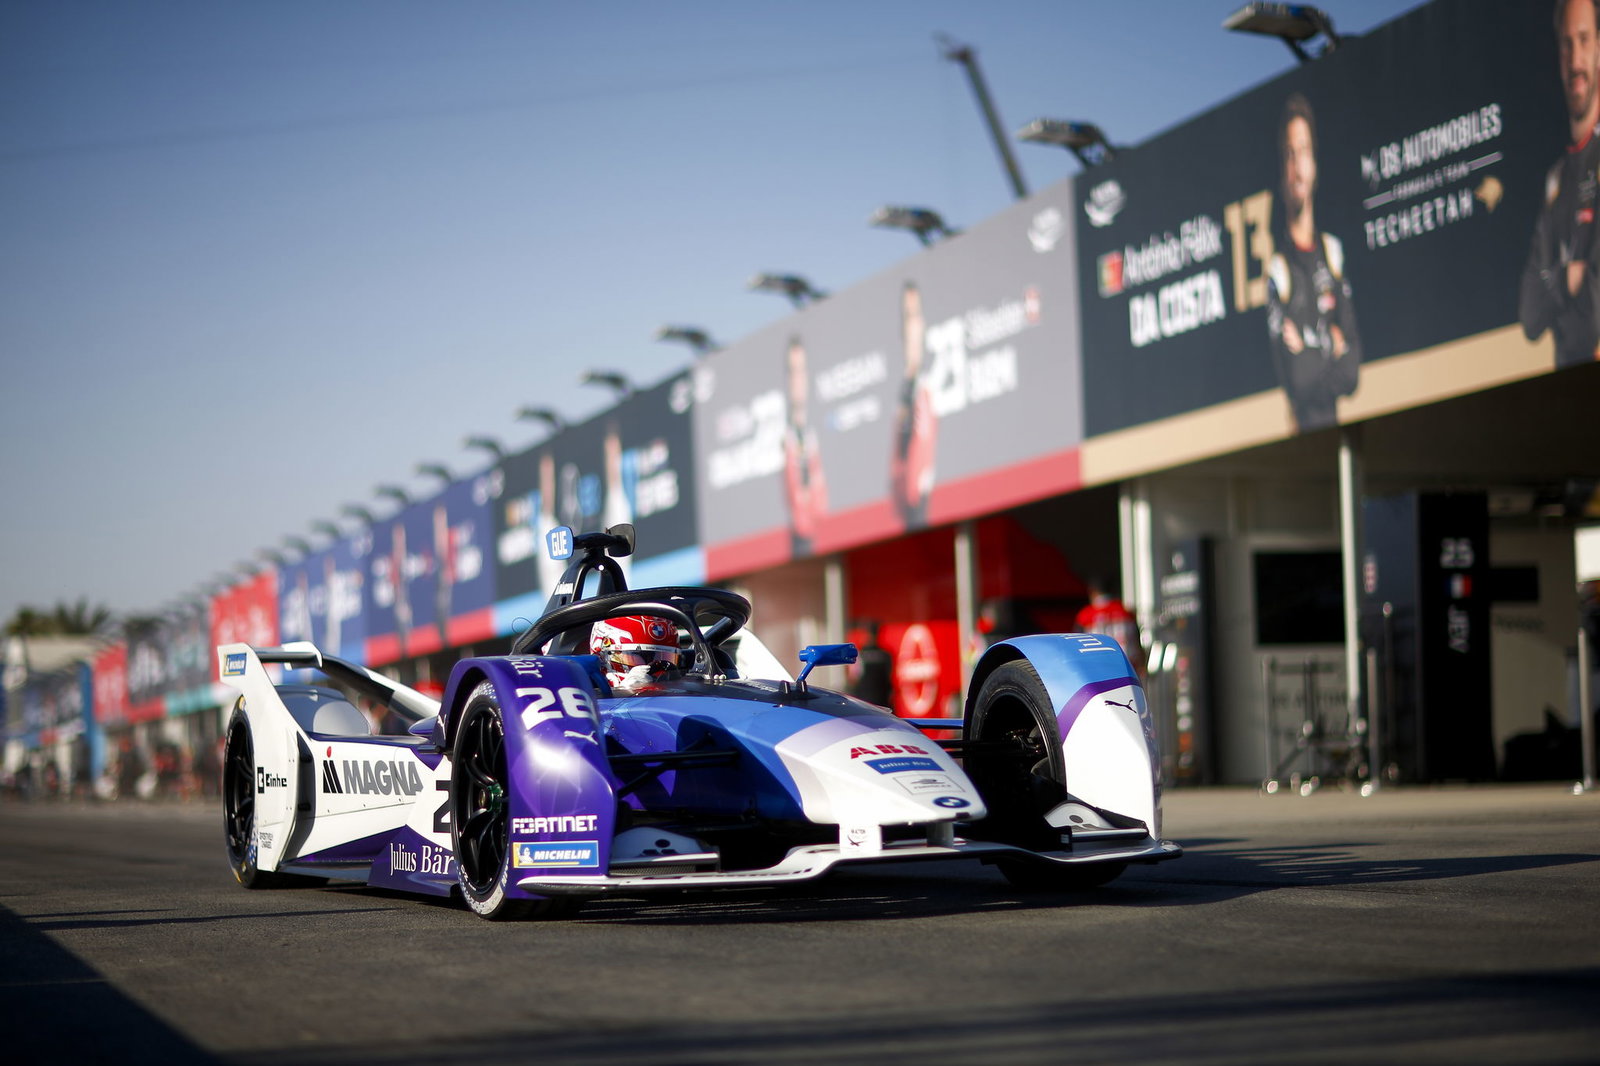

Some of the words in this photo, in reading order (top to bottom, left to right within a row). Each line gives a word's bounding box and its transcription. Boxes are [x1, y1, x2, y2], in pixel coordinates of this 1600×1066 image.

[1402, 103, 1502, 171] AUTOMOBILES
[1364, 188, 1473, 250] TECHEETAH
[1223, 190, 1271, 313] 13
[1129, 293, 1160, 347] DA
[1158, 269, 1226, 338] COSTA
[551, 529, 568, 558] GUE
[850, 744, 929, 759] ABB
[343, 760, 423, 796] MAGNA
[390, 842, 417, 876] Julius
[420, 845, 455, 875] Bär
[533, 849, 591, 861] MICHELIN
